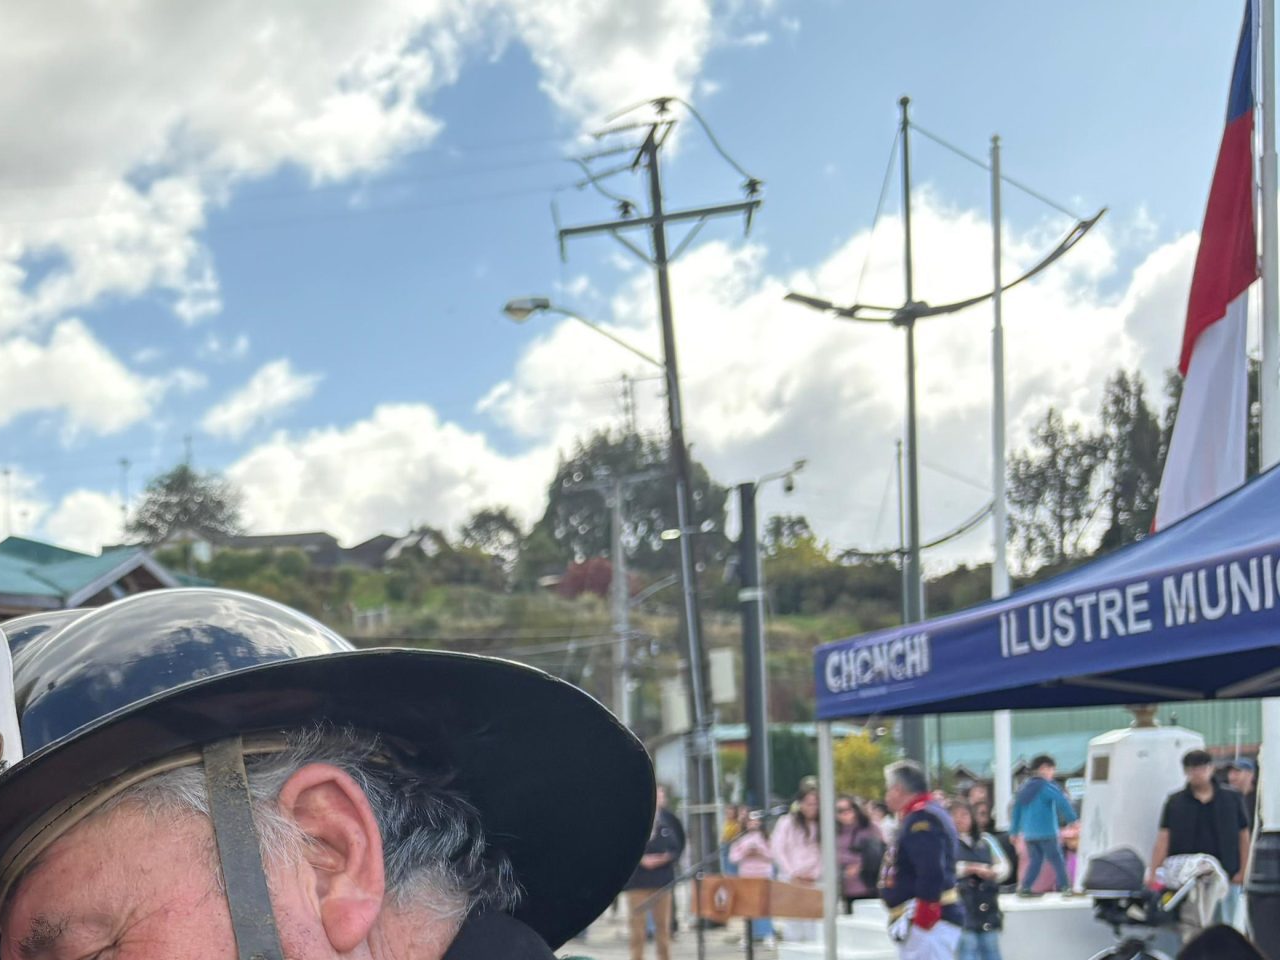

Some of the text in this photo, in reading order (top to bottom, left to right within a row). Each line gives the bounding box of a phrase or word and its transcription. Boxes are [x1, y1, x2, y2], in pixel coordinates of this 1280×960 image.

[1000, 554, 1280, 659] ILUSTRE MUNI
[825, 632, 930, 693] CHONCHI
